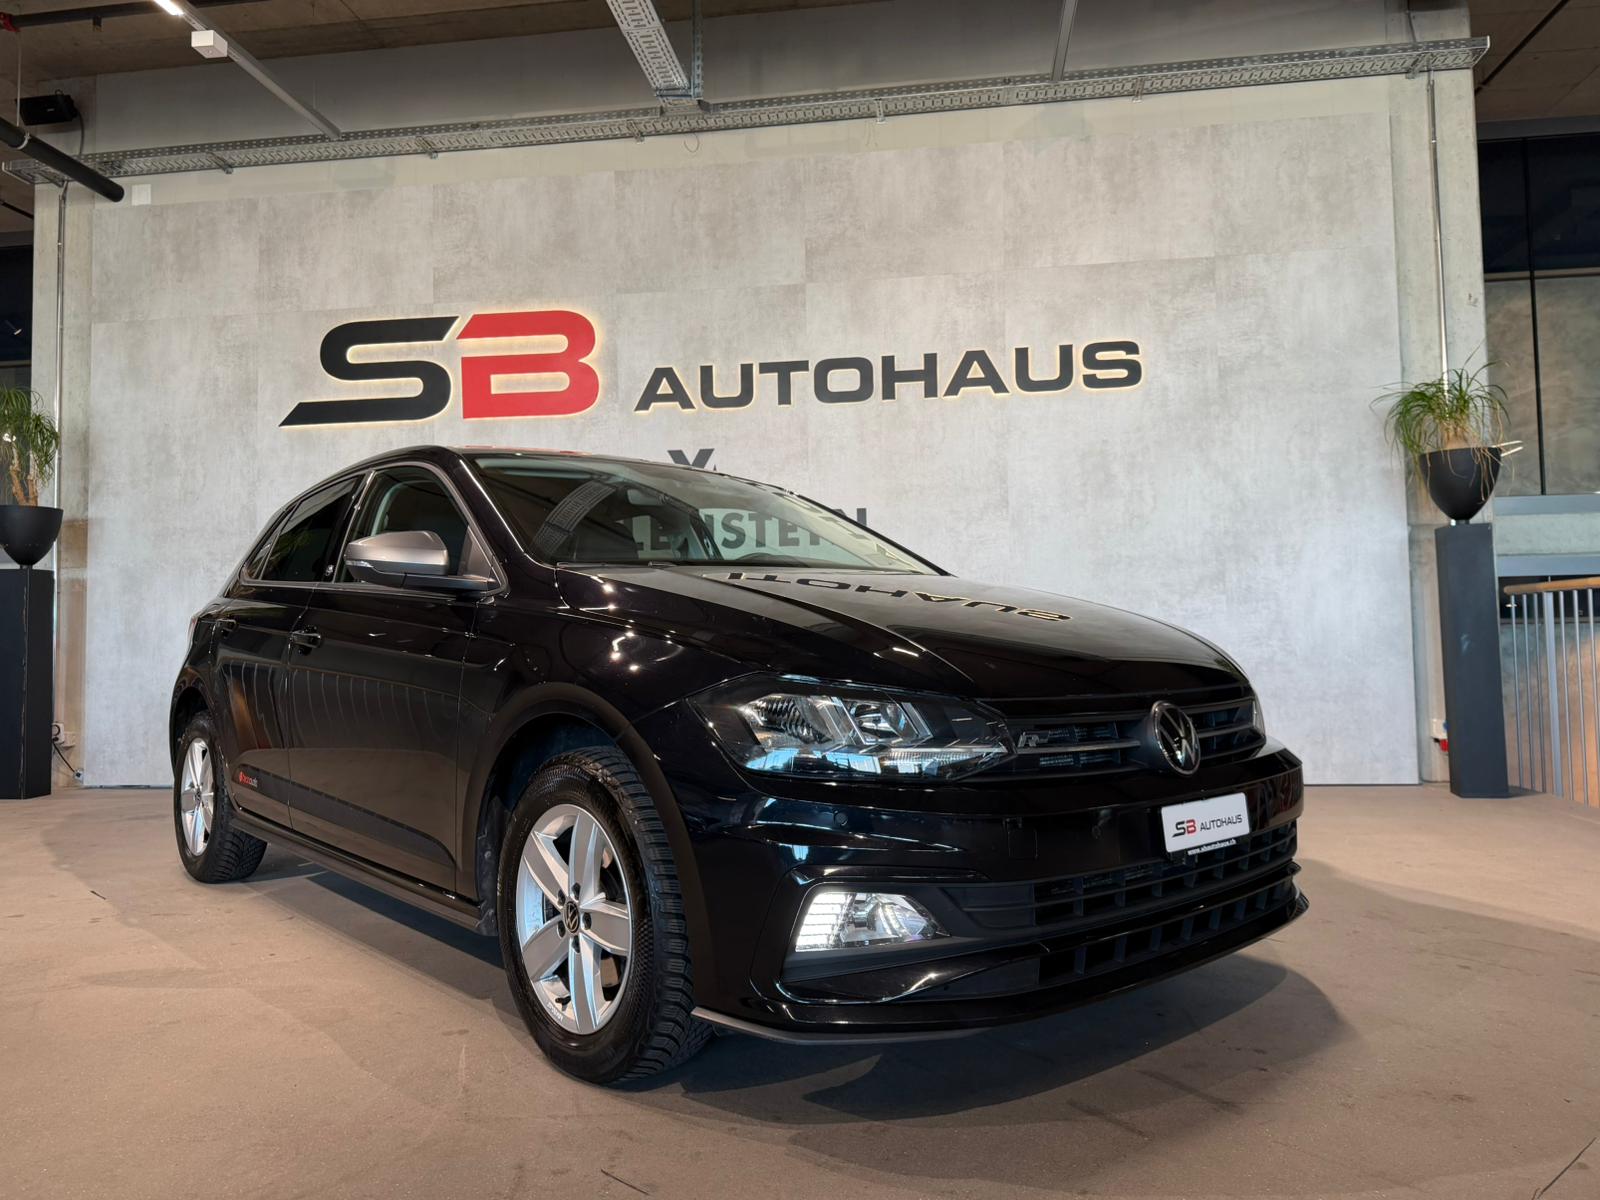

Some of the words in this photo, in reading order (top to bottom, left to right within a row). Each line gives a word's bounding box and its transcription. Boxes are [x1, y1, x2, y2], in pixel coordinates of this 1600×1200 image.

[278, 309, 600, 428] SB
[633, 339, 1143, 413] AUTOHAUS
[1171, 818, 1197, 838] SB
[1200, 814, 1243, 832] AUTOHAUS
